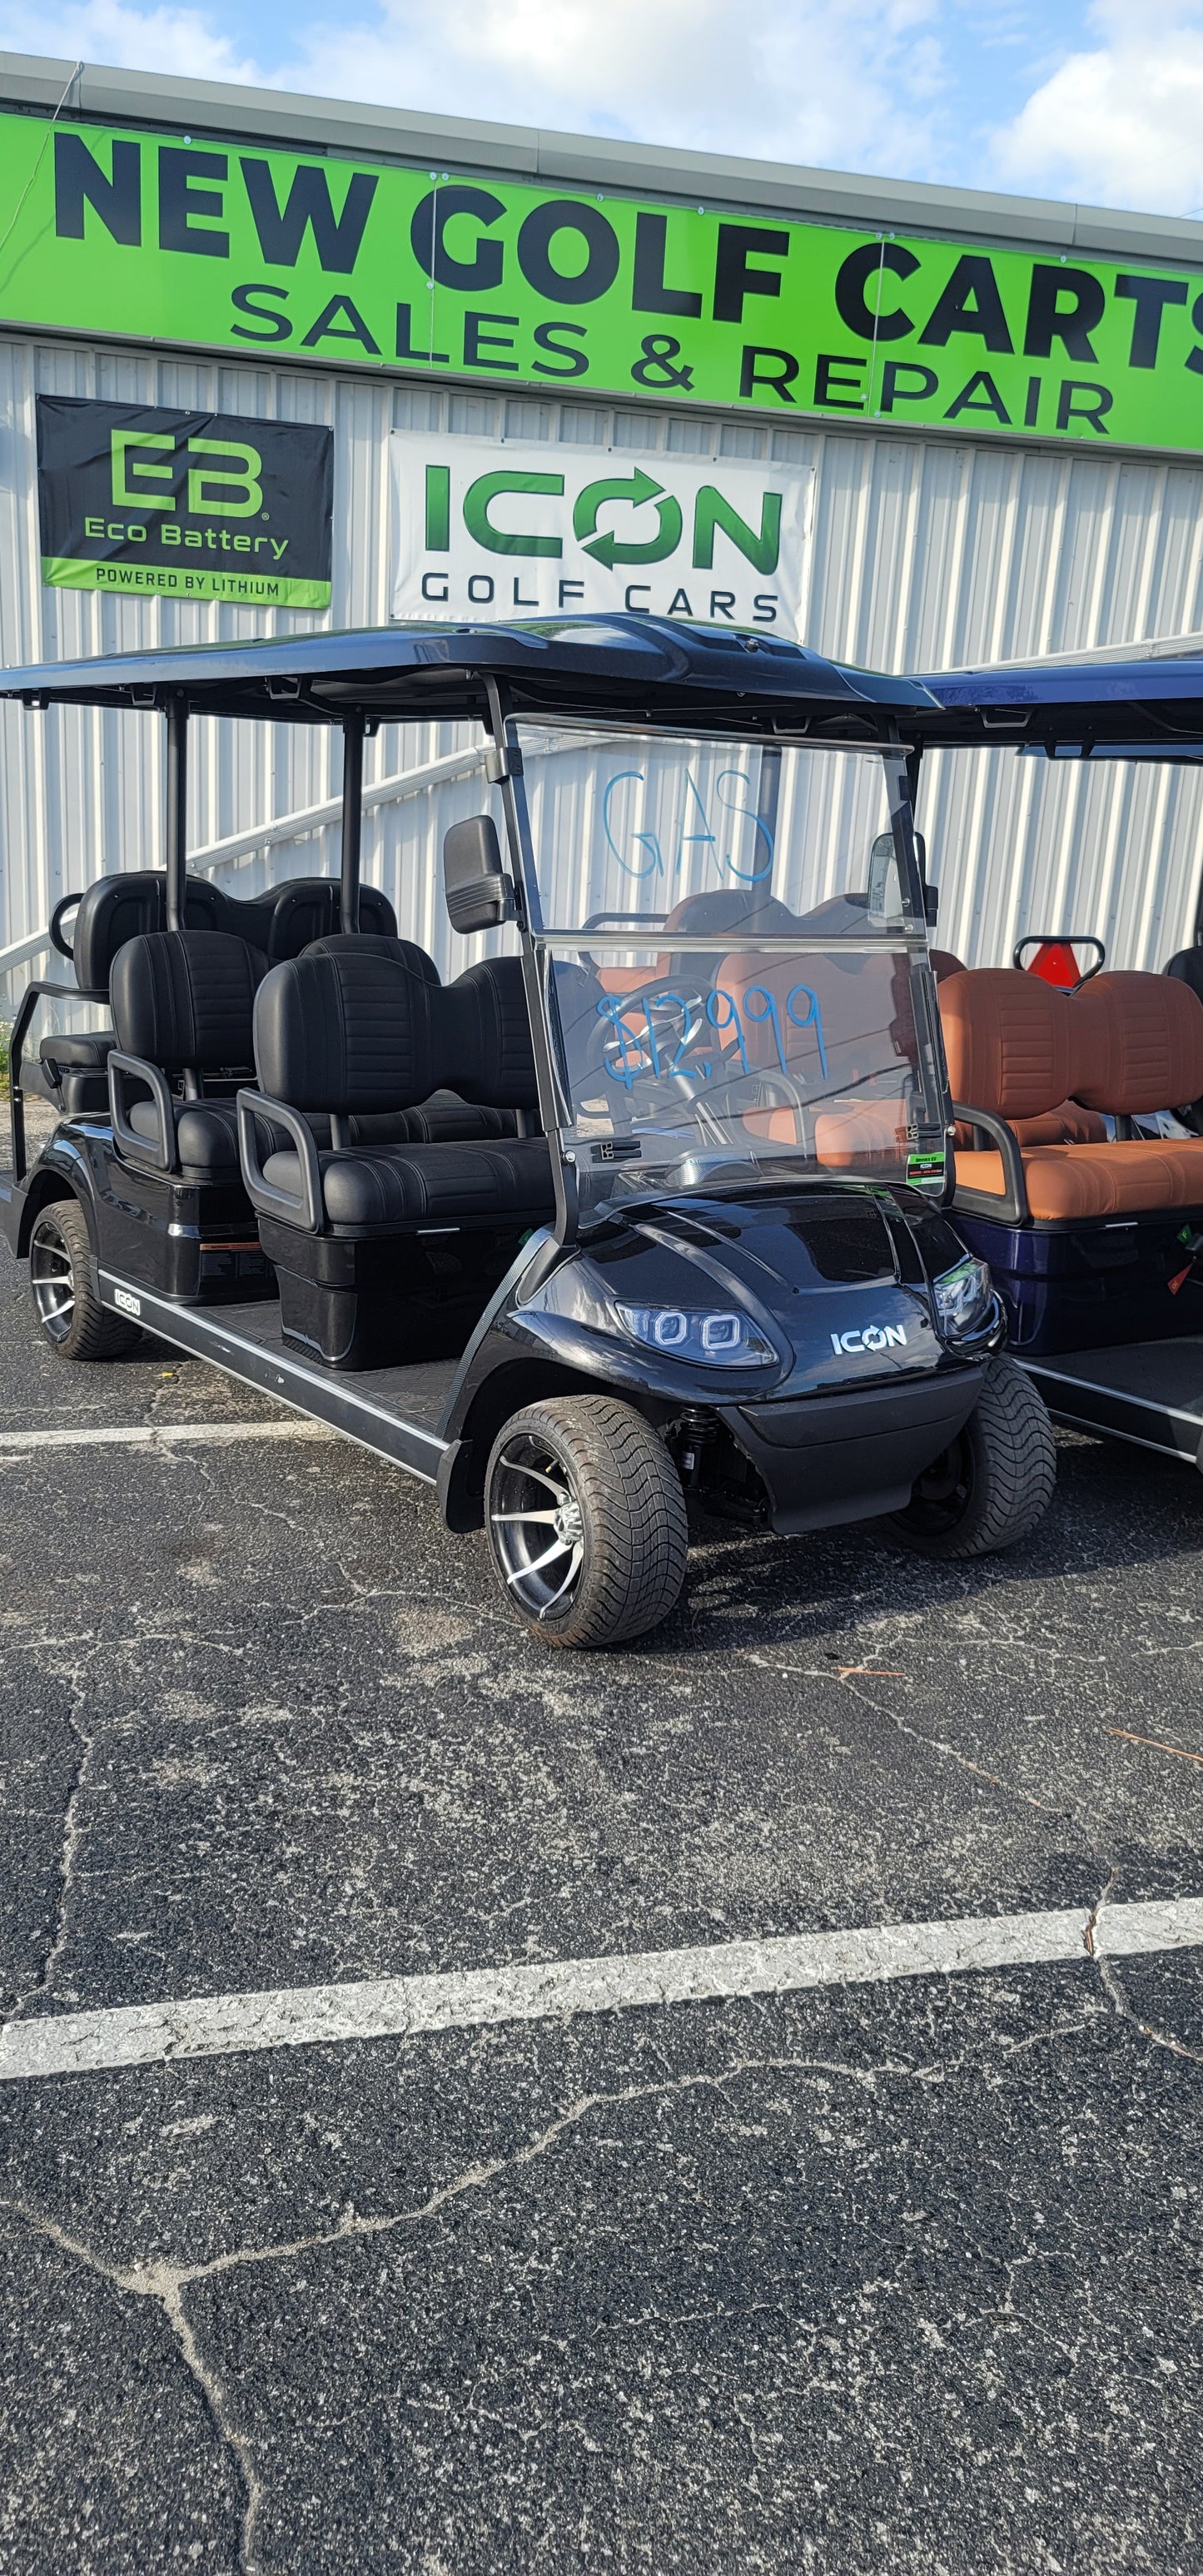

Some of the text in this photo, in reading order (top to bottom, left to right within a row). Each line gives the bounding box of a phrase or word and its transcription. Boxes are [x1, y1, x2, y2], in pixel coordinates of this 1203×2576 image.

[54, 132, 1203, 376] NEW GOLF CART
[230, 283, 1114, 435] SALES & REPAIR
[111, 429, 263, 519] EB
[84, 516, 289, 560] Eco Battery
[425, 465, 783, 575] ICON
[96, 568, 279, 596] POWERED BY LITHIUM
[421, 572, 778, 623] GOLF CARS
[602, 768, 774, 883] GAS
[596, 985, 828, 1089] $12,999
[114, 1289, 140, 1315] ICON
[830, 1325, 907, 1355] ICON
